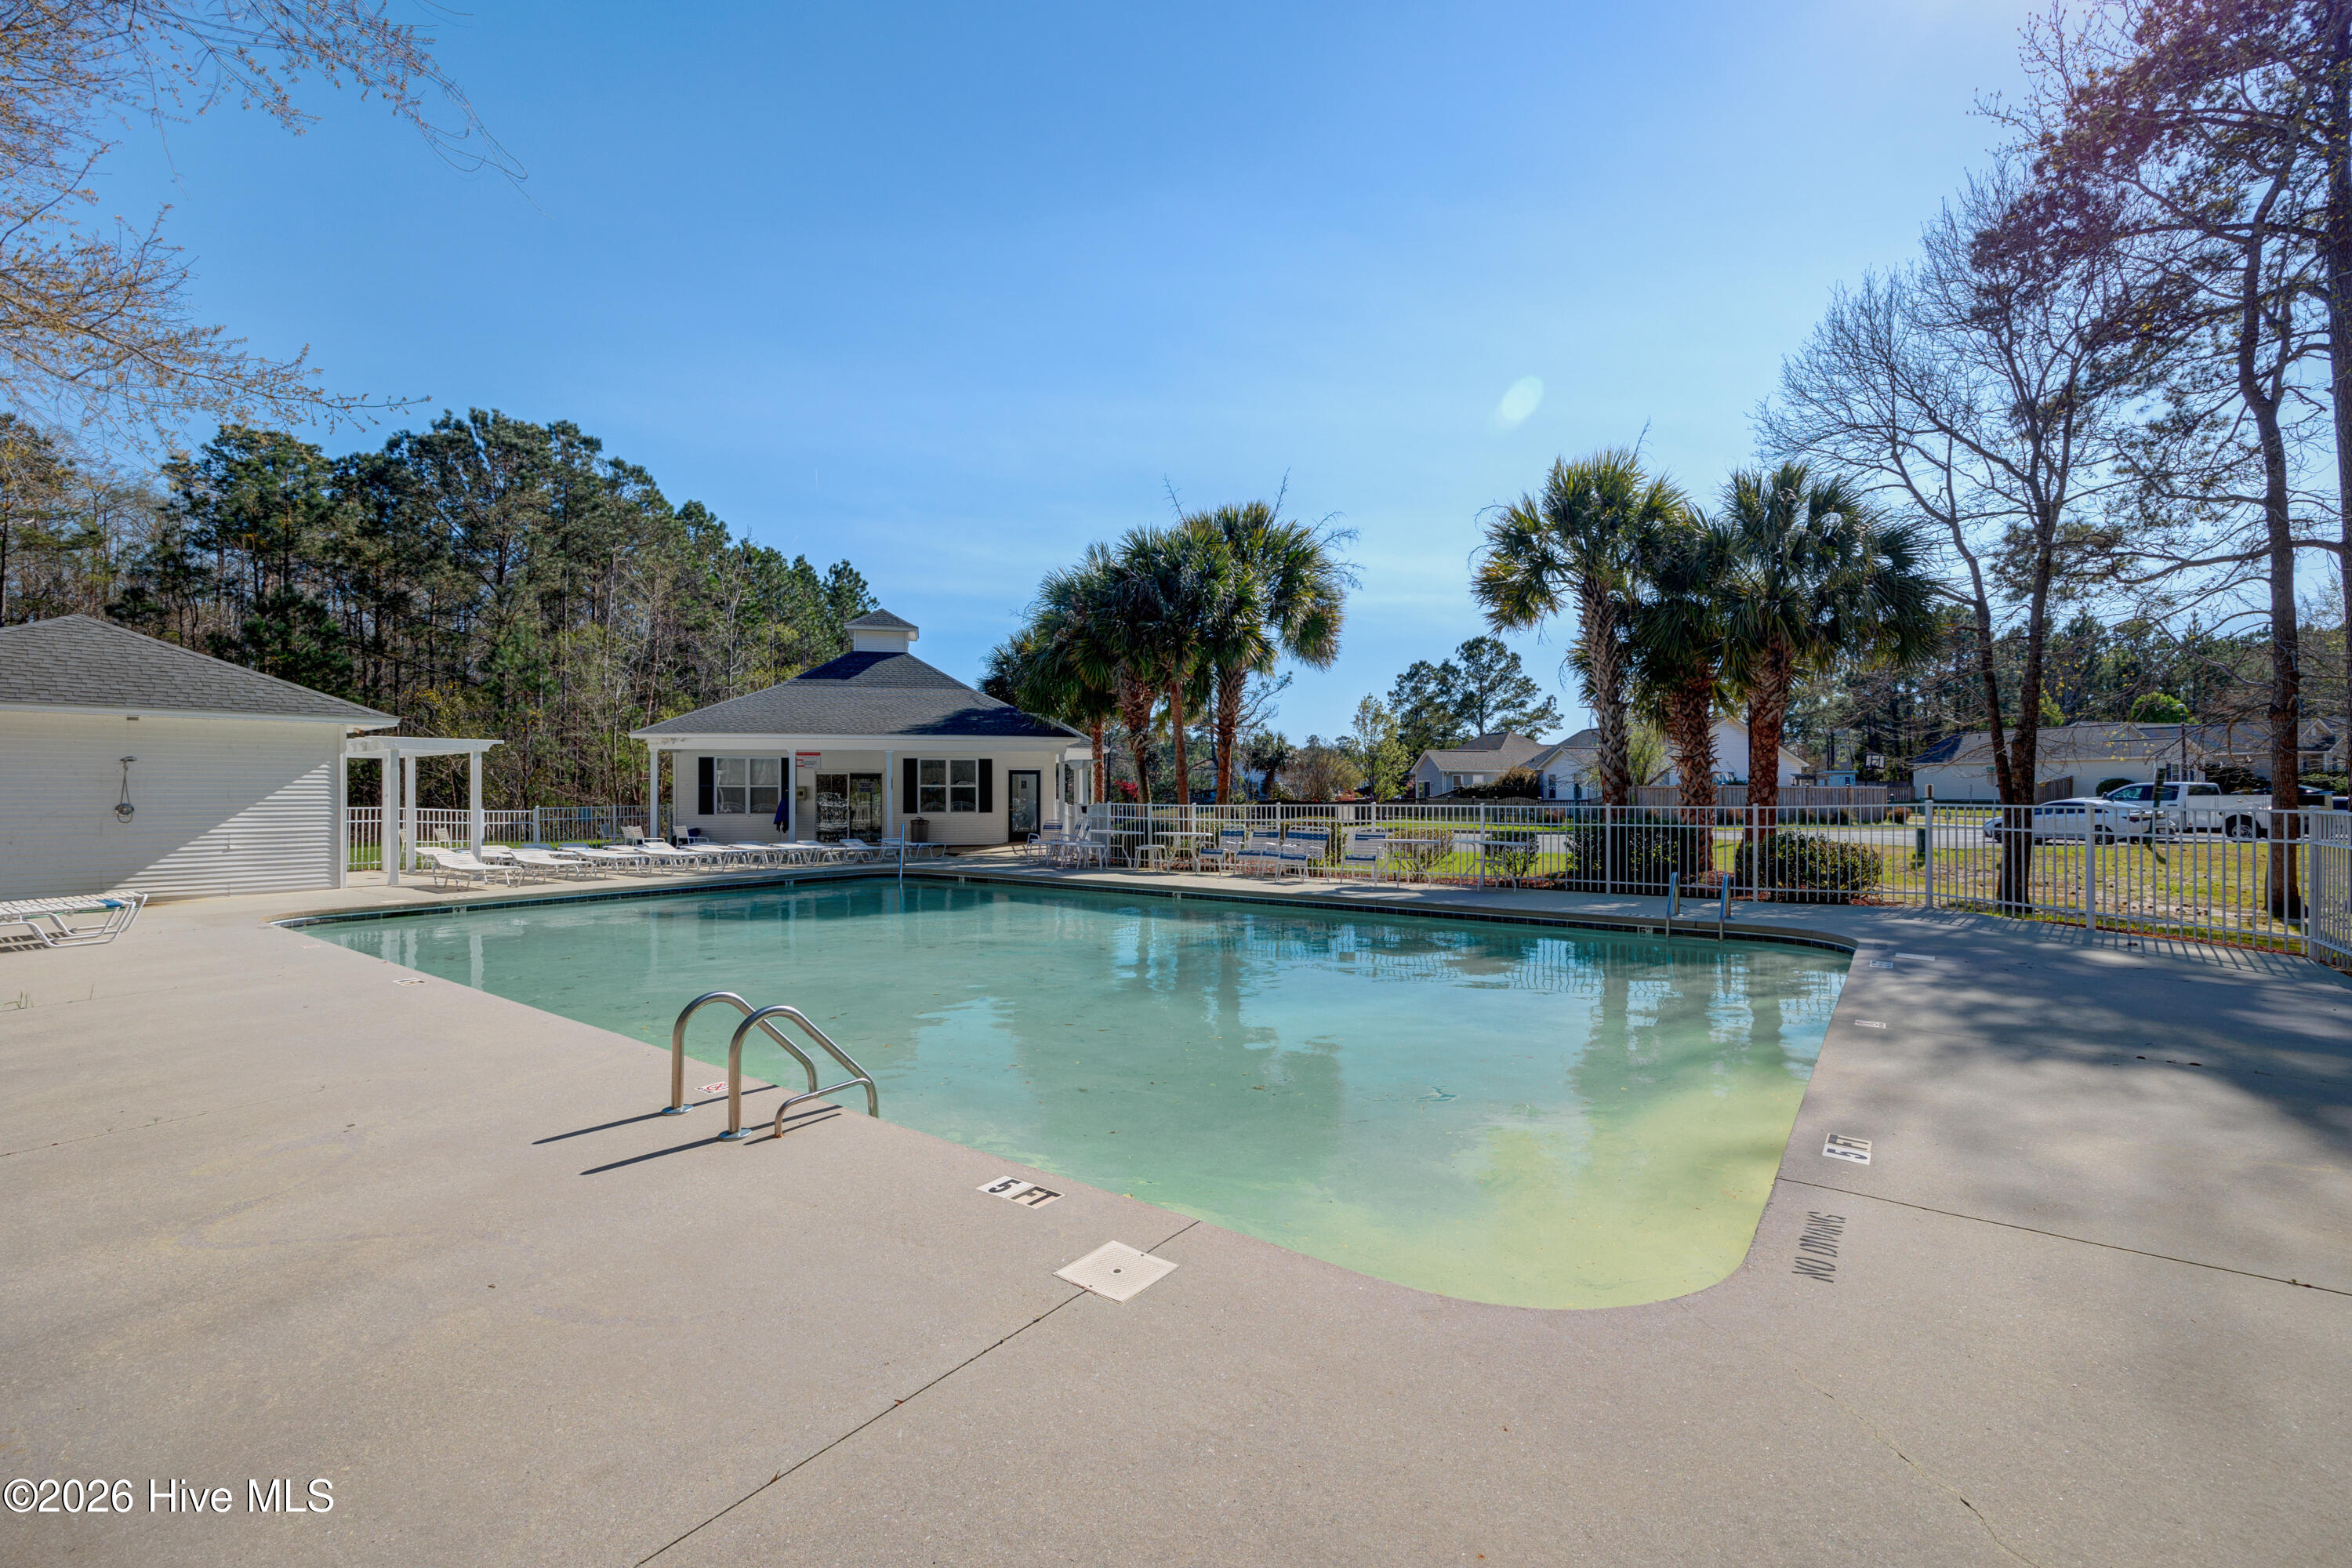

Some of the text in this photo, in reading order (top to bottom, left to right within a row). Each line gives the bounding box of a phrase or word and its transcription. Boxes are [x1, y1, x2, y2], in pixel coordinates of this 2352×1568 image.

[1826, 1134, 1868, 1160] 5 FT
[988, 1178, 1062, 1206] 5 FT
[1791, 1211, 1847, 1283] NO DIVING
